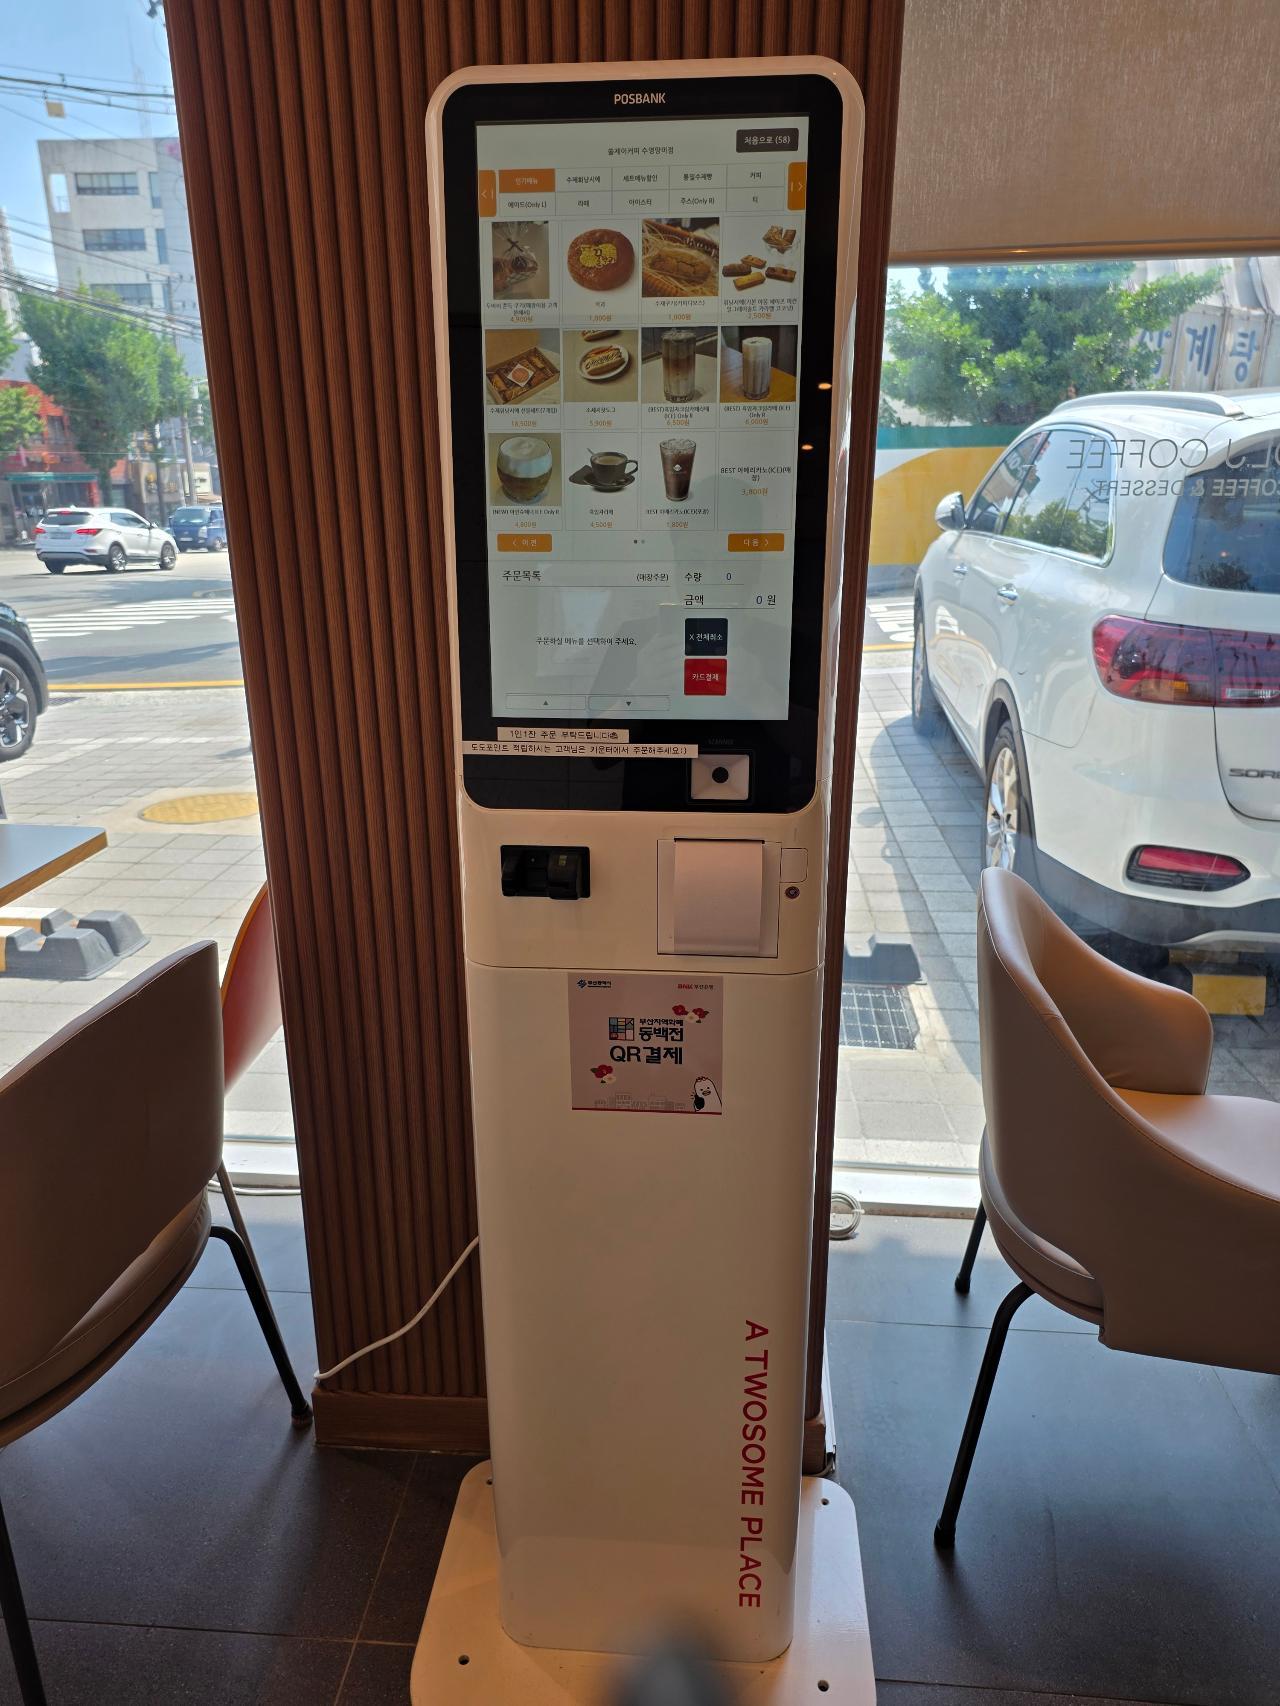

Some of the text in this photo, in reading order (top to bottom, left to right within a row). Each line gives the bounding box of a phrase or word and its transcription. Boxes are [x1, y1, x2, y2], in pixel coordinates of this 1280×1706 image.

[614, 92, 666, 105] POSBANK
[743, 135, 791, 145] 처음으로 (58)
[749, 171, 762, 180] 커피
[628, 198, 652, 206] 아이스티
[502, 570, 542, 582] 주문목록
[684, 572, 732, 582] 수량 0
[684, 594, 776, 606] 금액 0 원
[535, 636, 563, 646] 주문하실
[692, 673, 719, 682] 카드결제
[509, 730, 536, 739] 1인1잔
[540, 730, 556, 740] 주문
[471, 743, 509, 752] 도도포인트
[513, 743, 551, 753] 적립하시는
[555, 745, 586, 754] 고객님은
[590, 745, 629, 754] 카운터에서
[638, 1027, 684, 1042] 동백전
[738, 1319, 769, 1608] A TWOSOME PLACE
